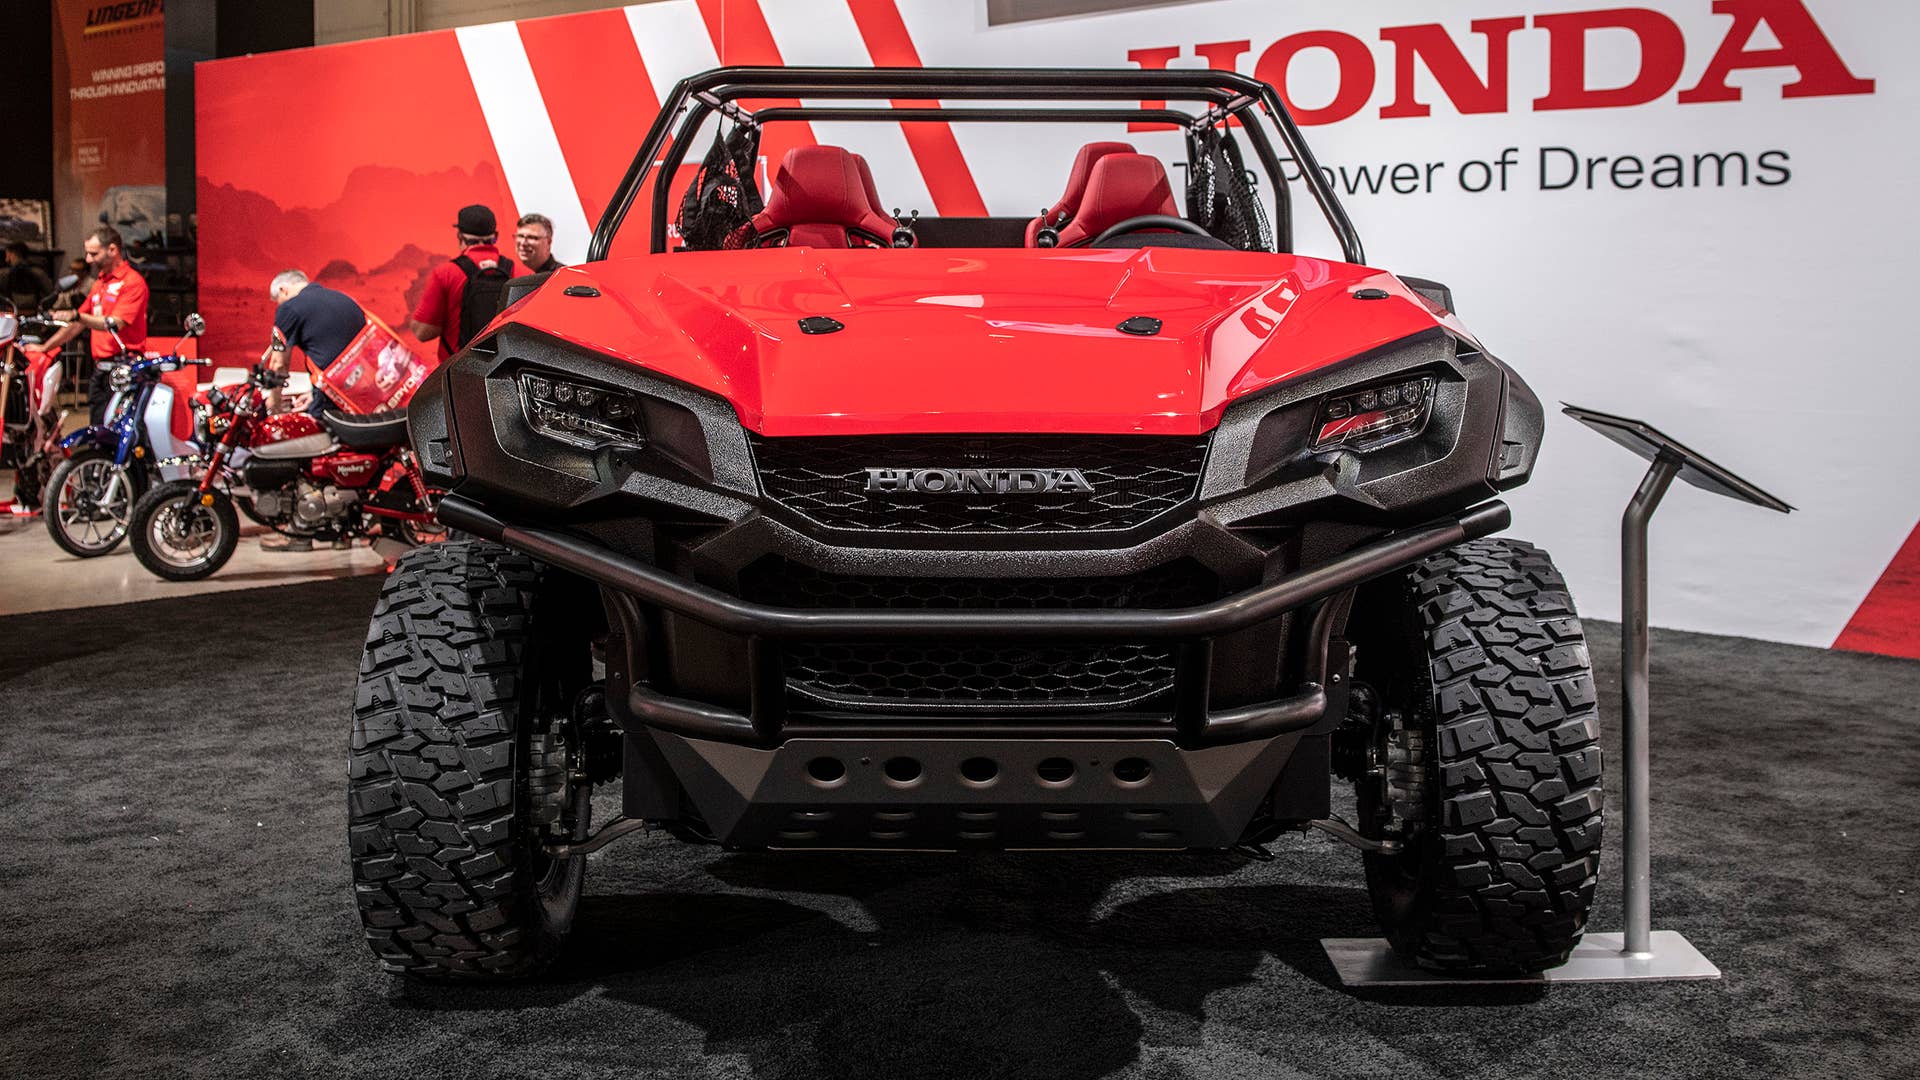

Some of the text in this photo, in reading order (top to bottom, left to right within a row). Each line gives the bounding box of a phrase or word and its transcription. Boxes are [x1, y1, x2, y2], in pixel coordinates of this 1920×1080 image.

[91, 65, 132, 82] WINNING
[70, 84, 112, 100] THROUGH
[1458, 147, 1518, 193] of
[1539, 146, 1792, 191] Dreams
[337, 464, 364, 477] Monkey
[864, 467, 1095, 494] HONDA
